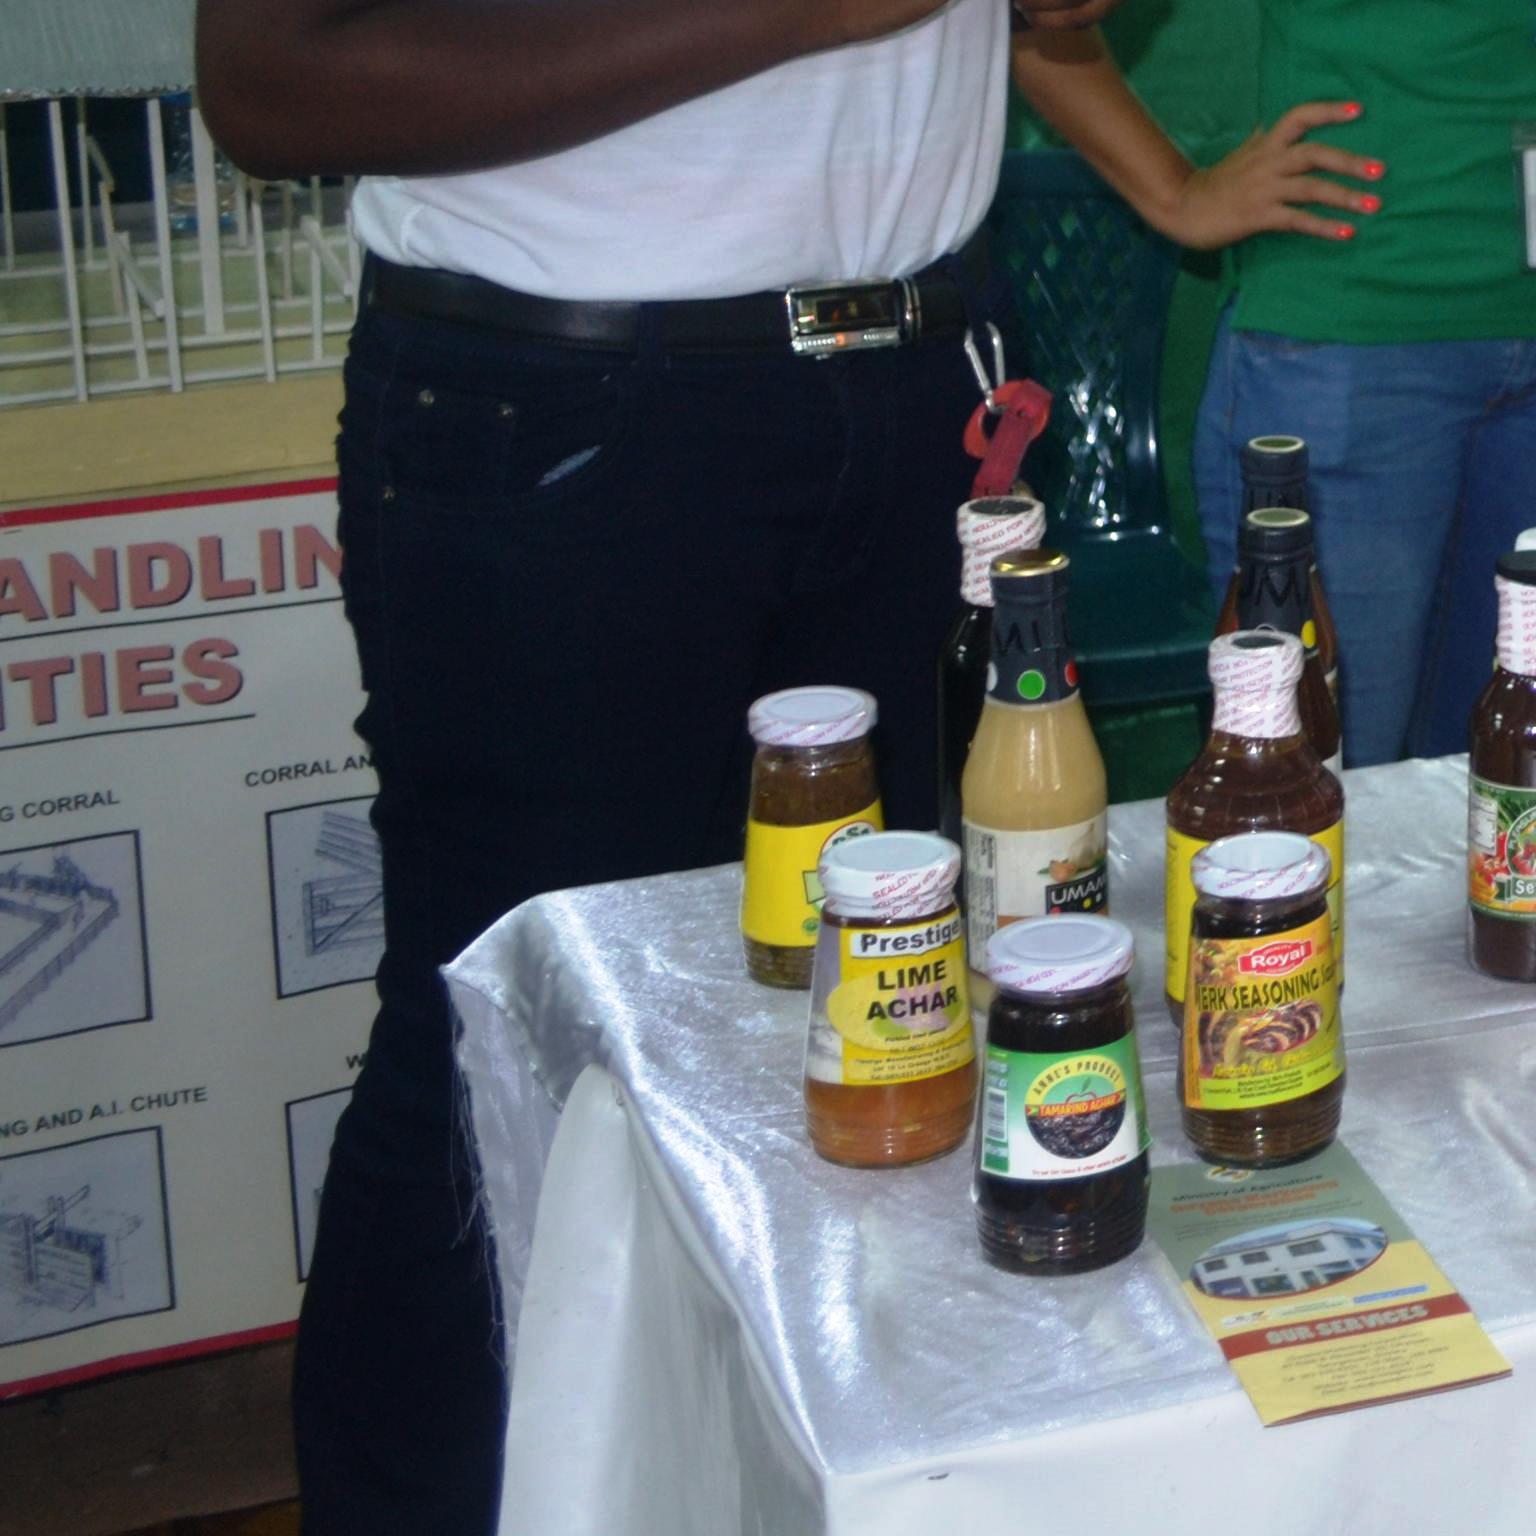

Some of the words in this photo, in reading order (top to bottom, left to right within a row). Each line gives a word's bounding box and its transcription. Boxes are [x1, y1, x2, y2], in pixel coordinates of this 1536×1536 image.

[244, 758, 338, 789] CORRAL
[22, 789, 121, 821] CORRAL
[860, 920, 962, 955] Prestige
[1250, 944, 1306, 970] Royal
[876, 959, 948, 993] LIME
[1231, 967, 1320, 1011] SEASONING
[866, 985, 960, 1023] ACHAR
[35, 1106, 84, 1133] AND
[89, 1100, 124, 1124] A.I.
[129, 1085, 209, 1114] CHUTE
[1041, 1101, 1089, 1117] TAMARIND
[1090, 1096, 1116, 1112] ACHAR
[1265, 1324, 1317, 1346] OUR
[1315, 1304, 1430, 1337] SERVICES
